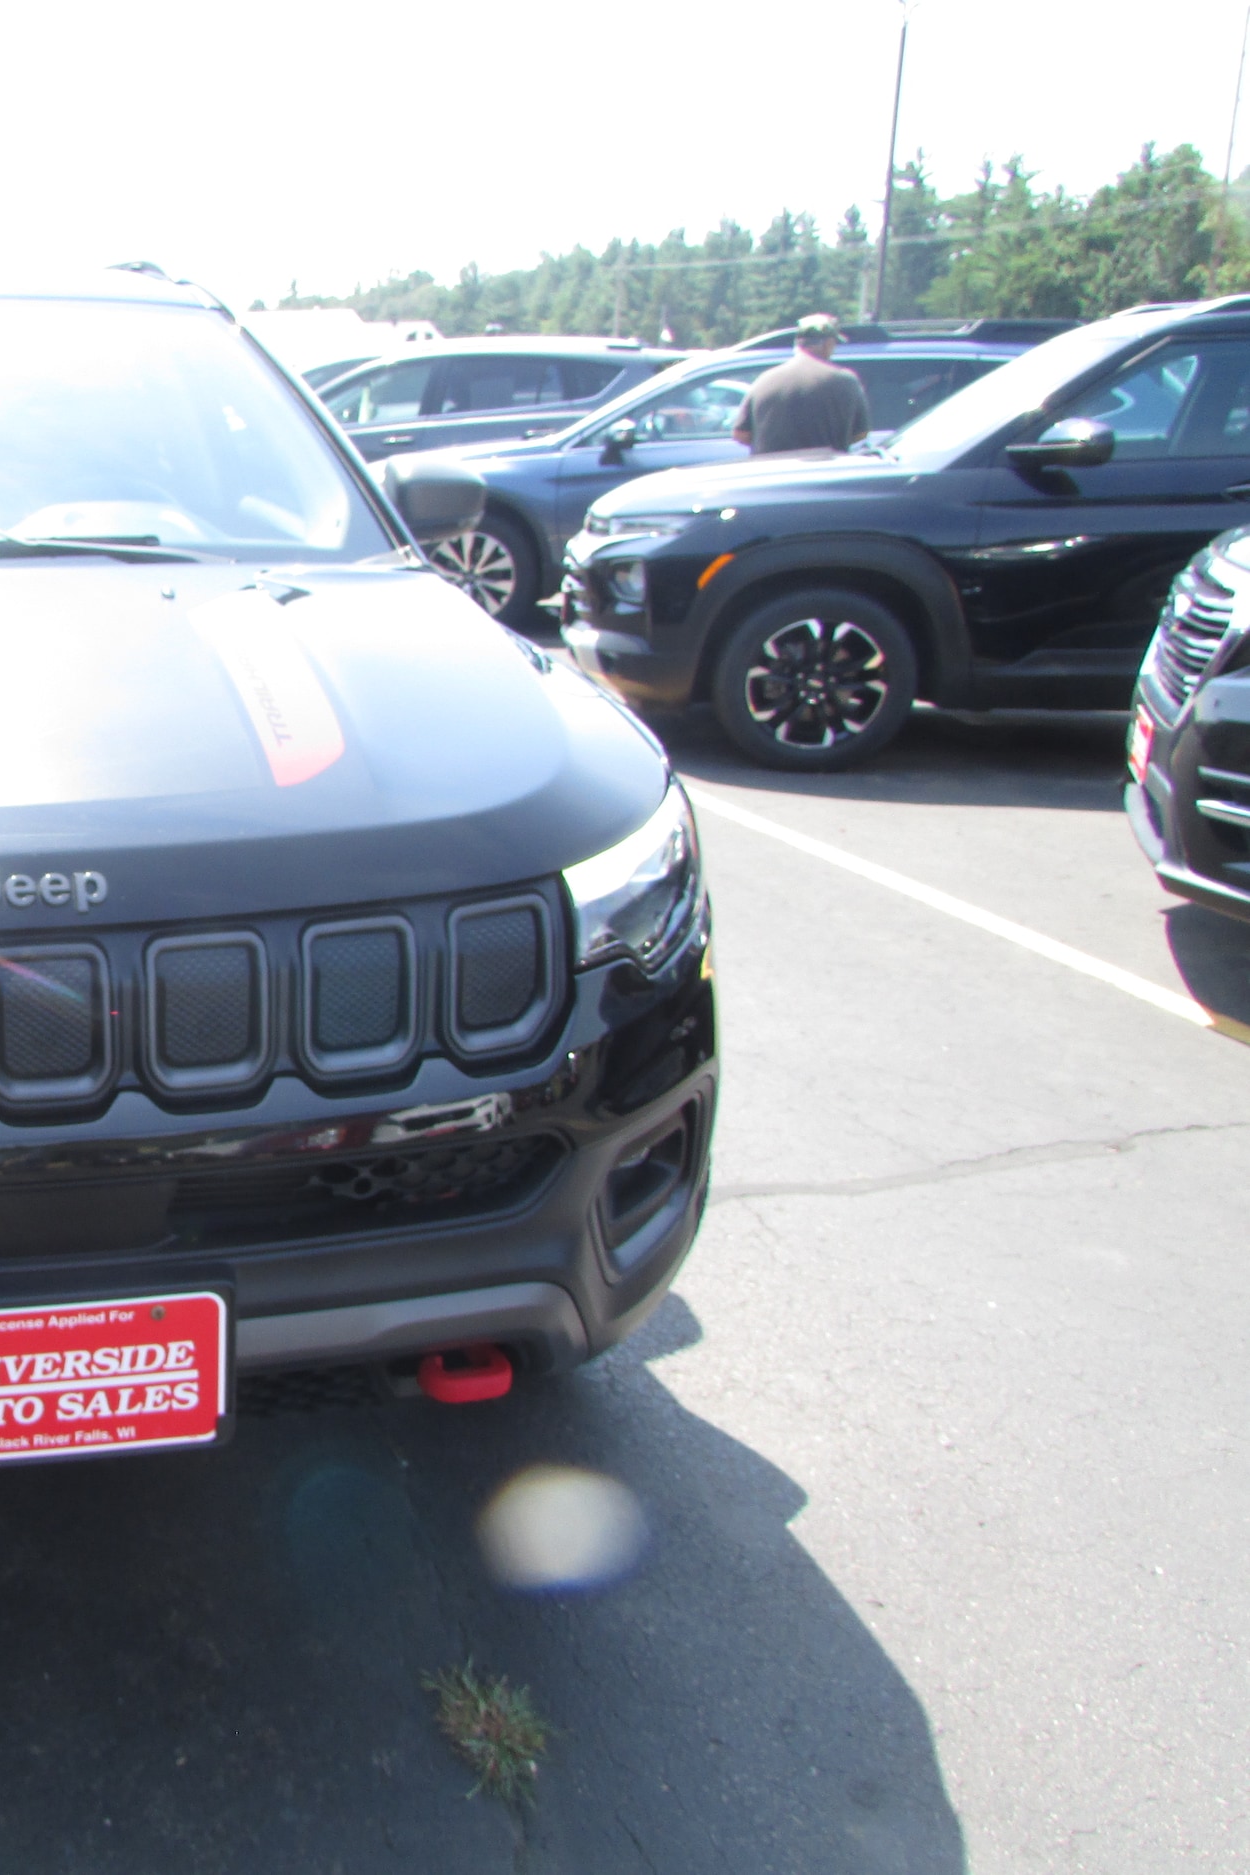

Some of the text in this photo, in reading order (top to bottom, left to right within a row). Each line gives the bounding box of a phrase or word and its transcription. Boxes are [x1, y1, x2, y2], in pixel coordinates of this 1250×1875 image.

[48, 1312, 106, 1329] Applied
[109, 1310, 135, 1323] For
[56, 1382, 199, 1422] SALES
[33, 1433, 71, 1447] River
[75, 1429, 114, 1443] Falls,
[117, 1426, 136, 1439] WI
